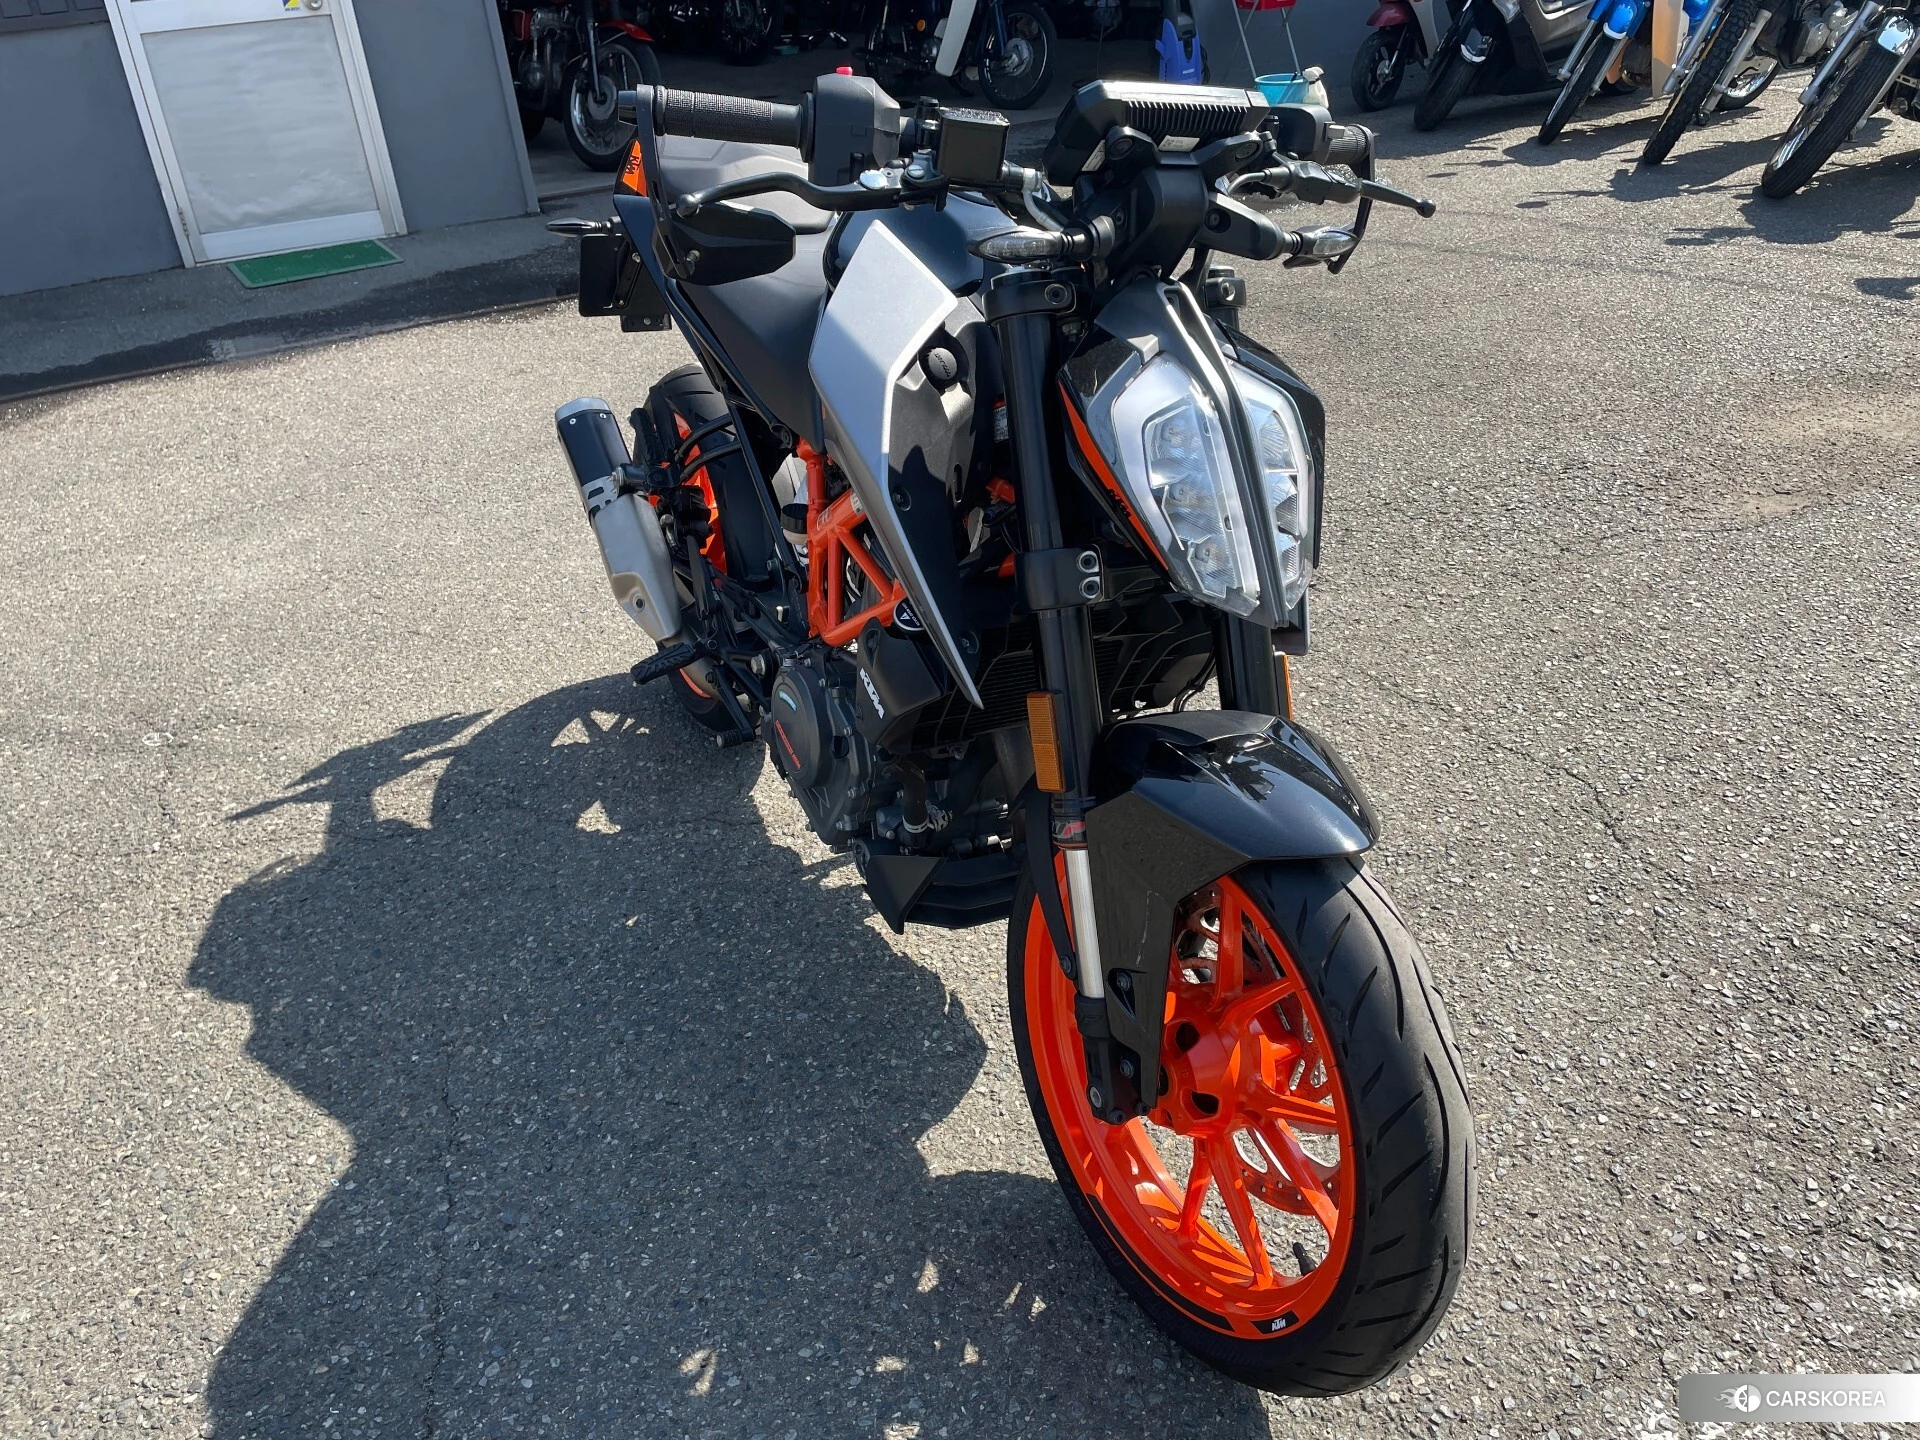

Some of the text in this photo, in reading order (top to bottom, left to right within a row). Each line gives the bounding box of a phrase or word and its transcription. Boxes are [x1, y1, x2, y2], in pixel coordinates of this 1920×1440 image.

[625, 154, 641, 175] KTM
[859, 667, 885, 720] KTM
[1271, 1317, 1287, 1332] KTM
